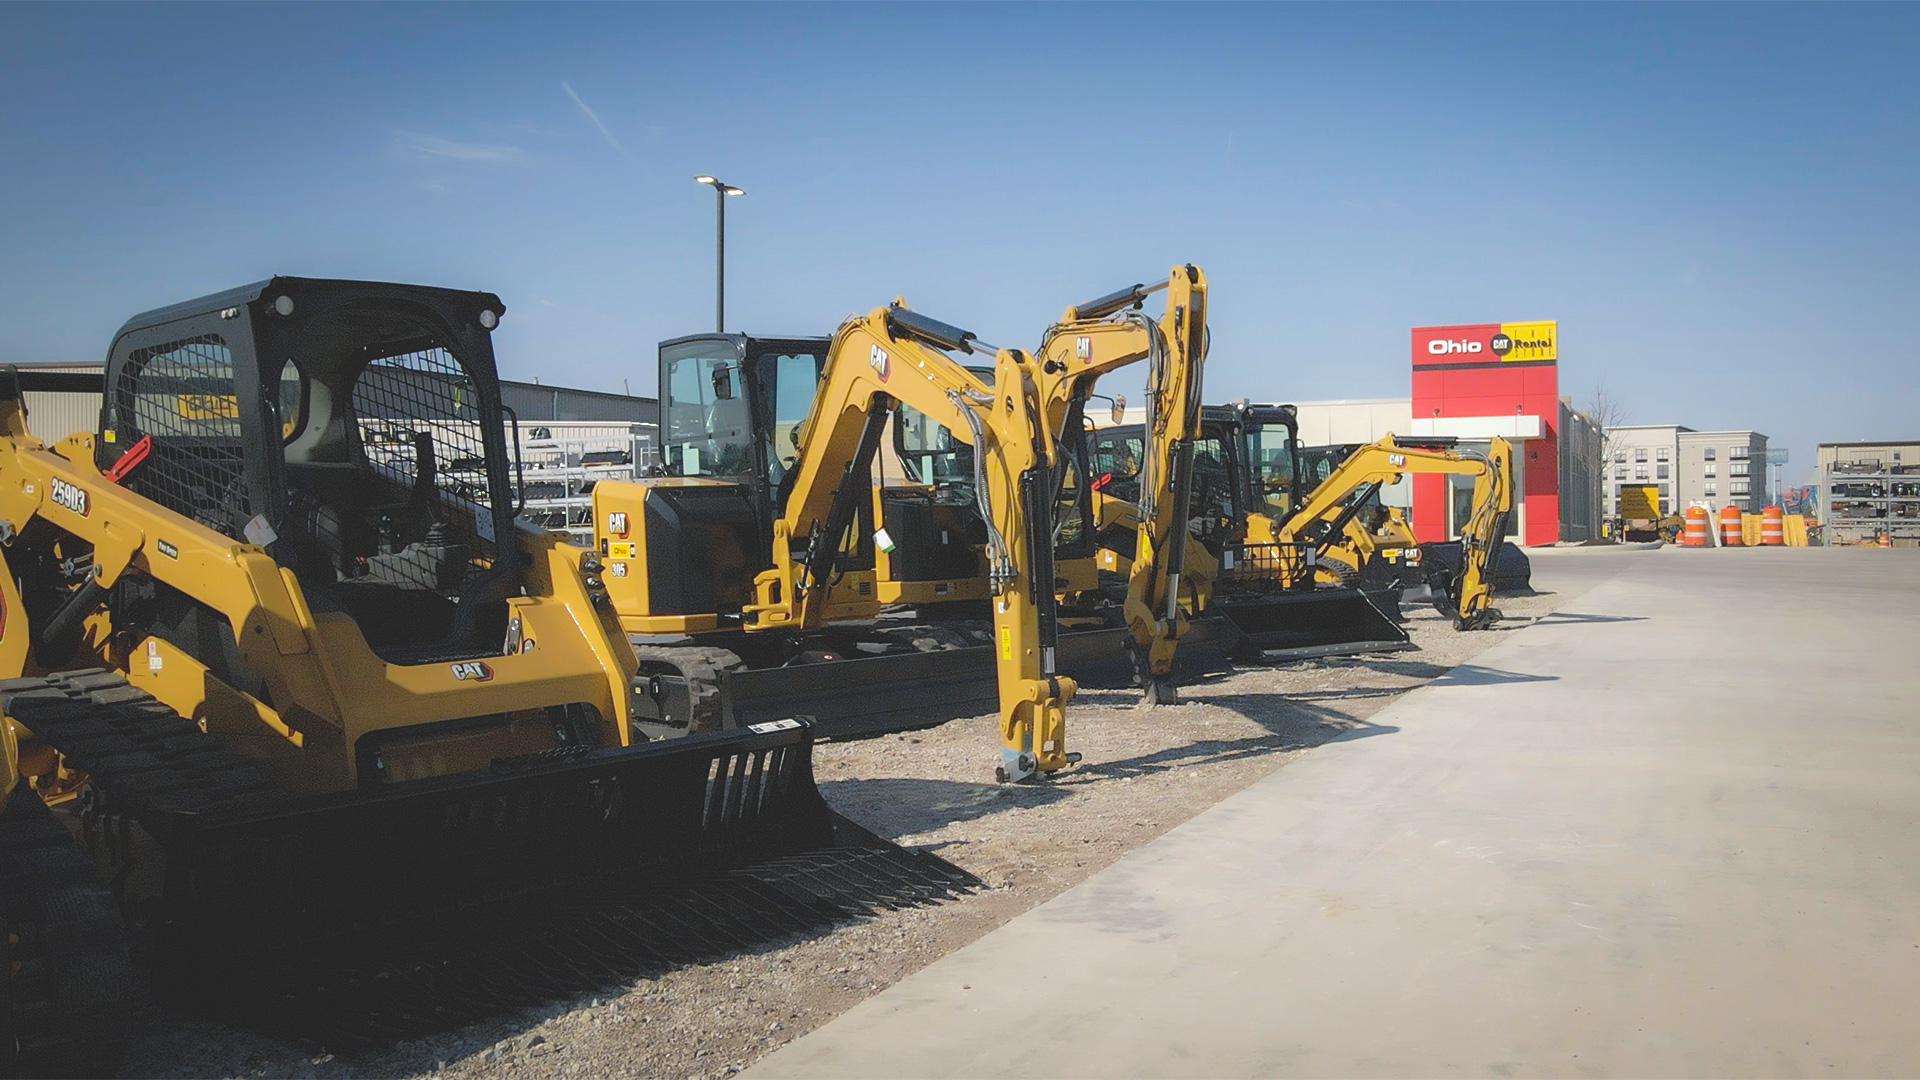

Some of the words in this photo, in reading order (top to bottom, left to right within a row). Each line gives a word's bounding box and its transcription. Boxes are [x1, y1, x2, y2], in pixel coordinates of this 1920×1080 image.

[1076, 336, 1090, 358] CAT
[1428, 339, 1482, 354] Ohio
[1493, 339, 1509, 350] CAT
[1514, 338, 1552, 349] Rental
[870, 343, 888, 376] CAT
[1389, 454, 1404, 466] CAT
[51, 477, 86, 515] 259D3
[609, 513, 626, 534] CAT
[613, 547, 627, 555] Ohio
[1405, 549, 1418, 559] CAT
[612, 563, 625, 577] 305
[451, 662, 485, 680] CAT
